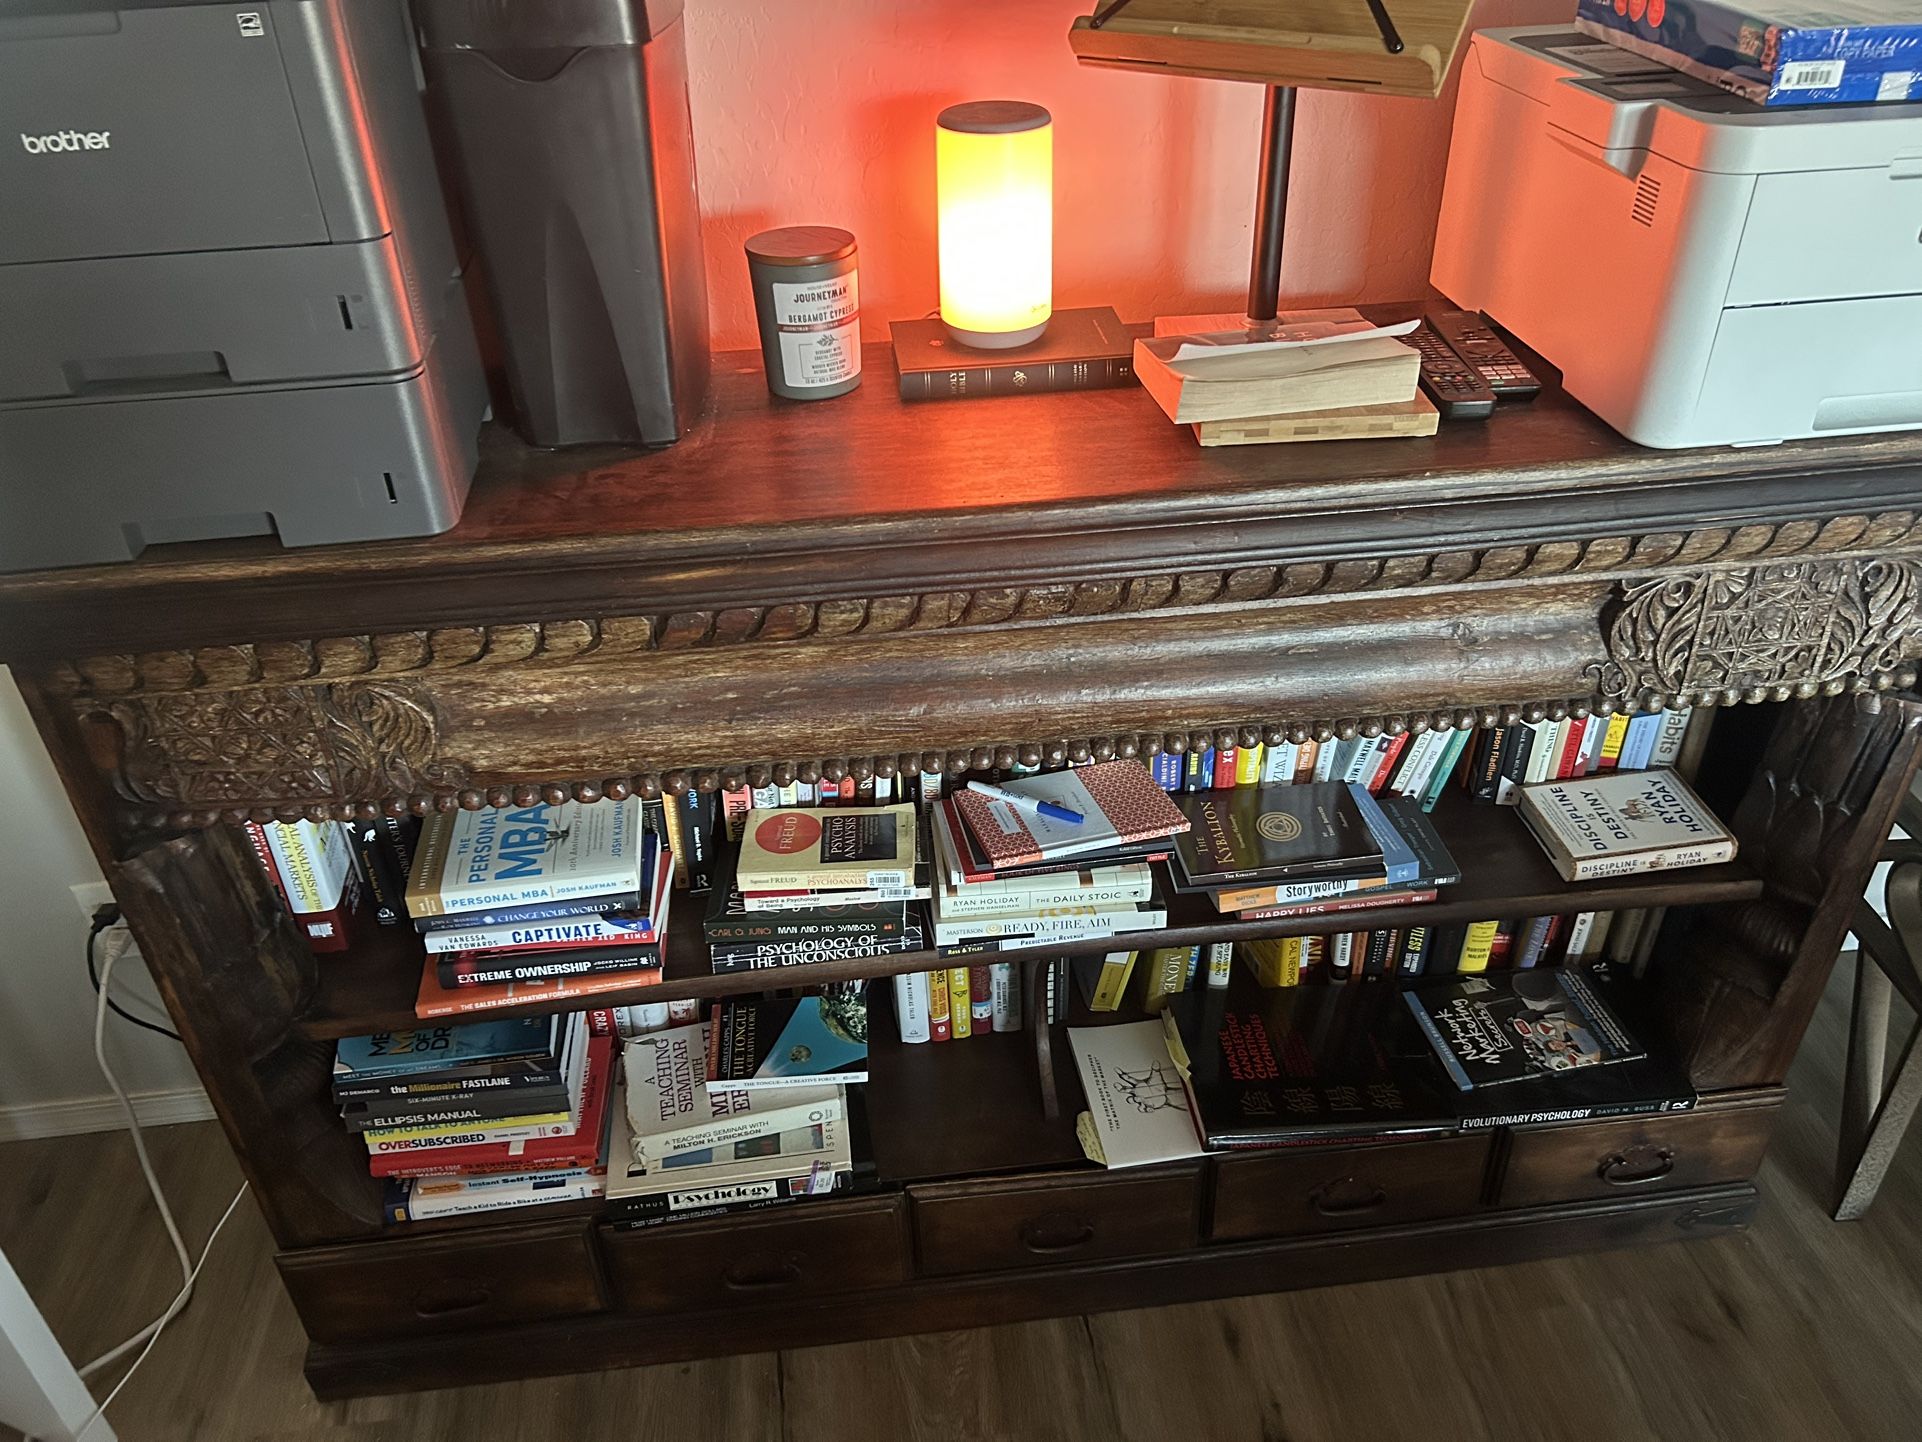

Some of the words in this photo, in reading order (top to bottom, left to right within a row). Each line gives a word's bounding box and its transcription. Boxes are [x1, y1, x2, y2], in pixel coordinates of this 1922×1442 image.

[20, 130, 110, 154] brother
[794, 286, 847, 303] JOURNEYMAN
[788, 312, 828, 323] BERGAMOT
[830, 304, 854, 319] CYPRESS
[1494, 728, 1504, 750] Jason
[1660, 710, 1688, 754] Habits
[1355, 739, 1374, 768] MAXWELL
[1398, 750, 1420, 786] CONFLICT
[1486, 750, 1500, 782] Fladlien
[670, 802, 678, 824] DAVID
[1580, 790, 1629, 840] DESTINY
[1641, 791, 1678, 824] RYAN
[1648, 779, 1703, 832] HOLIDAY
[614, 800, 624, 836] KAUFMAN
[1550, 786, 1608, 851] DISCIPLINE
[1585, 813, 1596, 821] IS
[494, 802, 551, 880] MBA
[778, 816, 798, 850] FREUD
[830, 816, 844, 854] PSYCHO-
[844, 817, 856, 860] ANALYSIS
[1200, 801, 1235, 865] KYBALION
[458, 837, 470, 855] THE
[468, 808, 499, 884] PERSONAL
[612, 837, 622, 857] JOSH
[1196, 836, 1208, 856] THE
[1676, 851, 1702, 860] RYAN
[292, 838, 318, 890] ANALYSIS
[1581, 860, 1638, 874] DISCIPLINE
[1592, 867, 1635, 878] DESTINY
[1666, 858, 1708, 868] HOLIDAY
[283, 852, 308, 902] MARKETS
[451, 893, 518, 908] PERSONAL
[522, 888, 548, 902] MBA
[578, 881, 617, 891] KAUFMAN
[1053, 894, 1084, 903] DAILY
[1088, 892, 1122, 900] STOIC
[1286, 880, 1348, 898] Storyworthy
[954, 898, 977, 906] RYAN
[980, 896, 1020, 906] HOLIDAY
[1366, 898, 1405, 908] DOUGHERTY
[497, 911, 540, 922] CHANGE
[541, 908, 567, 918] YOUR
[570, 904, 608, 914] WORLD
[512, 923, 602, 944] CAPTIVATE
[624, 932, 648, 940] KING
[711, 928, 732, 937] CARL
[749, 927, 772, 936] JUNG
[778, 926, 798, 934] MAN
[800, 925, 818, 933] AND
[821, 924, 835, 932] HIS
[838, 923, 876, 932] SYMBOLS
[946, 927, 984, 936] MASTERSON
[1004, 920, 1050, 934] READY,
[1052, 919, 1085, 930] FIRE,
[1087, 918, 1111, 928] AIM
[448, 934, 486, 944] VANESSA
[458, 940, 498, 950] EDWARDS
[758, 937, 856, 956] PSYCHOLOGY
[858, 935, 878, 945] OF
[1288, 940, 1298, 956] CAL
[749, 954, 778, 969] THE
[782, 945, 890, 966] UNCONSCIOUS
[458, 970, 513, 984] EXTREME
[515, 962, 592, 978] OWNERSHIP
[1286, 956, 1298, 984] NEWPO
[461, 1002, 474, 1010] THE
[474, 1000, 497, 1009] SALES
[498, 993, 548, 1006] ACCELERATION
[548, 988, 580, 998] FORMULA
[599, 1010, 608, 1036] CRAZY
[736, 1007, 748, 1052] TONGUE
[1452, 998, 1500, 1064] Marketing
[1479, 1008, 1508, 1048] Secrets
[415, 1034, 430, 1050] OF
[1224, 1011, 1255, 1080] CANDLESTICK
[1250, 1013, 1280, 1079] TECHNIQUES
[1434, 1010, 1480, 1060] Network
[1218, 1030, 1244, 1080] JAPANESE
[1242, 1023, 1268, 1080] CHARTING
[1436, 1036, 1454, 1062] RUSSELL
[692, 1058, 706, 1088] WITH
[734, 1052, 744, 1077] THE
[390, 1085, 408, 1094] the
[408, 1082, 462, 1094] Millionaire
[462, 1077, 511, 1089] FASTLANE
[644, 1076, 656, 1085] A
[656, 1038, 676, 1121] TEACHING
[672, 1039, 694, 1114] SEMINAR
[407, 1094, 450, 1104] SIX-MINUTE
[451, 1092, 474, 1100] X-RAY
[374, 1114, 426, 1128] ELLIPSIS
[428, 1109, 481, 1122] MANUAL
[1462, 1113, 1530, 1128] EVOLUTIONARY
[1530, 1108, 1591, 1122] PSYCHOLOGY
[368, 1128, 397, 1137] HOW
[399, 1126, 413, 1134] TO
[416, 1122, 446, 1132] TALK
[672, 1132, 712, 1145] TEACHING
[712, 1124, 748, 1137] SEMINAR
[749, 1120, 769, 1130] WITH
[673, 1140, 704, 1150] MILTON
[718, 1128, 762, 1142] ERICKSON
[378, 1133, 486, 1151] OVERSUBSCRIBED
[1230, 1141, 1270, 1150] JAPANESE
[1270, 1138, 1328, 1148] CANDLESTICK
[1328, 1136, 1374, 1144] CHARTING
[1375, 1134, 1427, 1142] TECHNIQUES
[502, 1171, 582, 1184] Self-Hypnosis
[627, 1201, 664, 1211] RATHUS
[672, 1184, 773, 1206] Psychology
